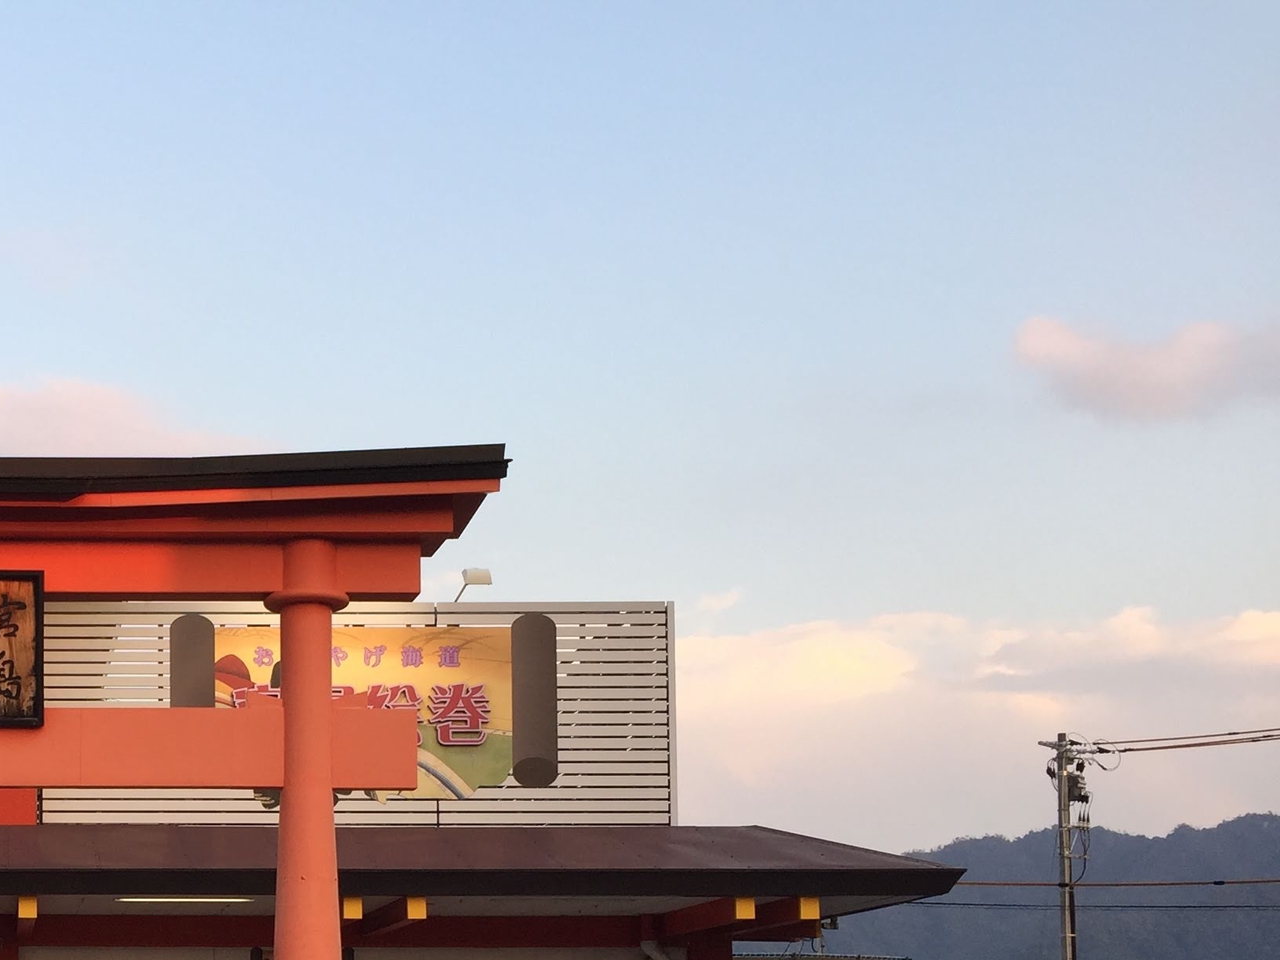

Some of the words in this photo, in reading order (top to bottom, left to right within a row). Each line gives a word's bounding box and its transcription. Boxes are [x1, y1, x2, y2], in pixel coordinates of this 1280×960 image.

[253, 644, 461, 668] おやげ海道
